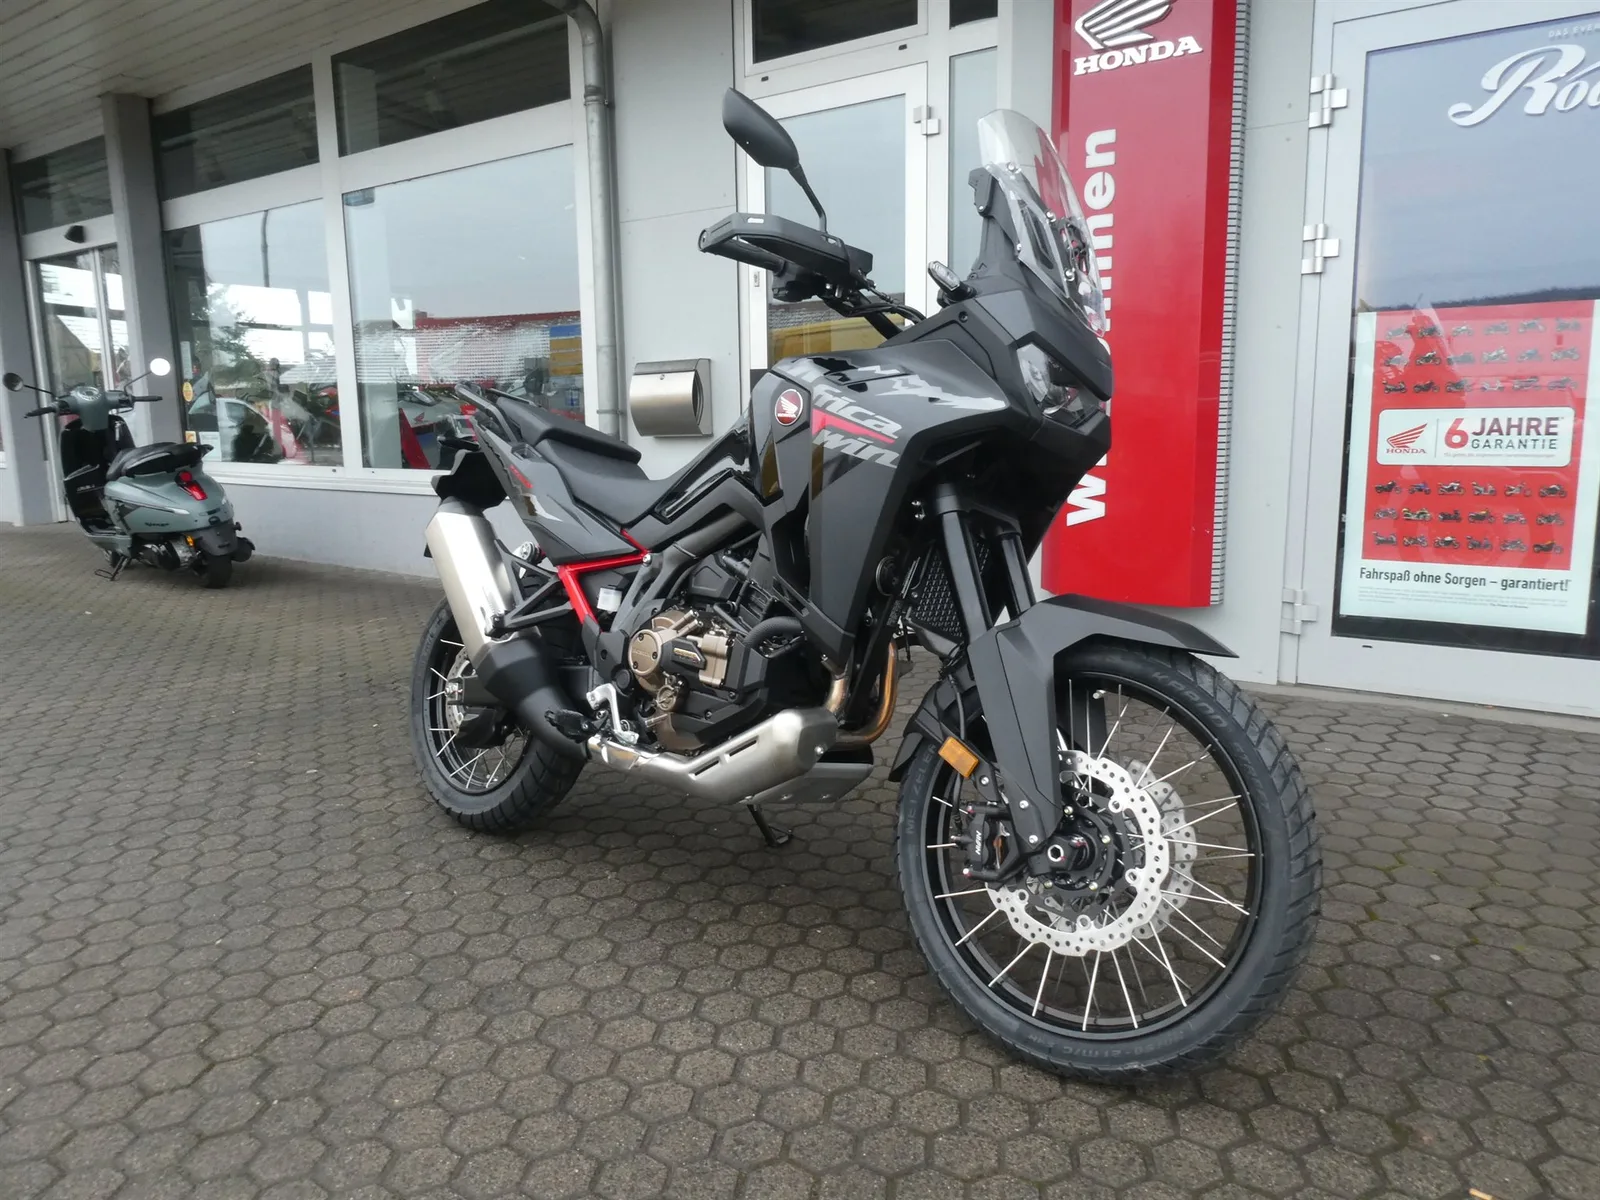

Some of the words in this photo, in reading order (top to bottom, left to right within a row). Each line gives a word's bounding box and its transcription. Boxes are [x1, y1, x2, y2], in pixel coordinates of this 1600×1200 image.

[1548, 27, 1569, 39] DAS
[1573, 22, 1600, 34] EVE
[1073, 35, 1204, 76] HONDA
[1444, 418, 1469, 449] 6
[1472, 417, 1559, 437] JAHRE
[1471, 438, 1558, 450] GARANTIE
[1360, 567, 1411, 583] Fahrspaß
[1413, 571, 1442, 584] ohne
[1444, 573, 1487, 589] Sorgen
[1501, 578, 1569, 592] garantiert!
